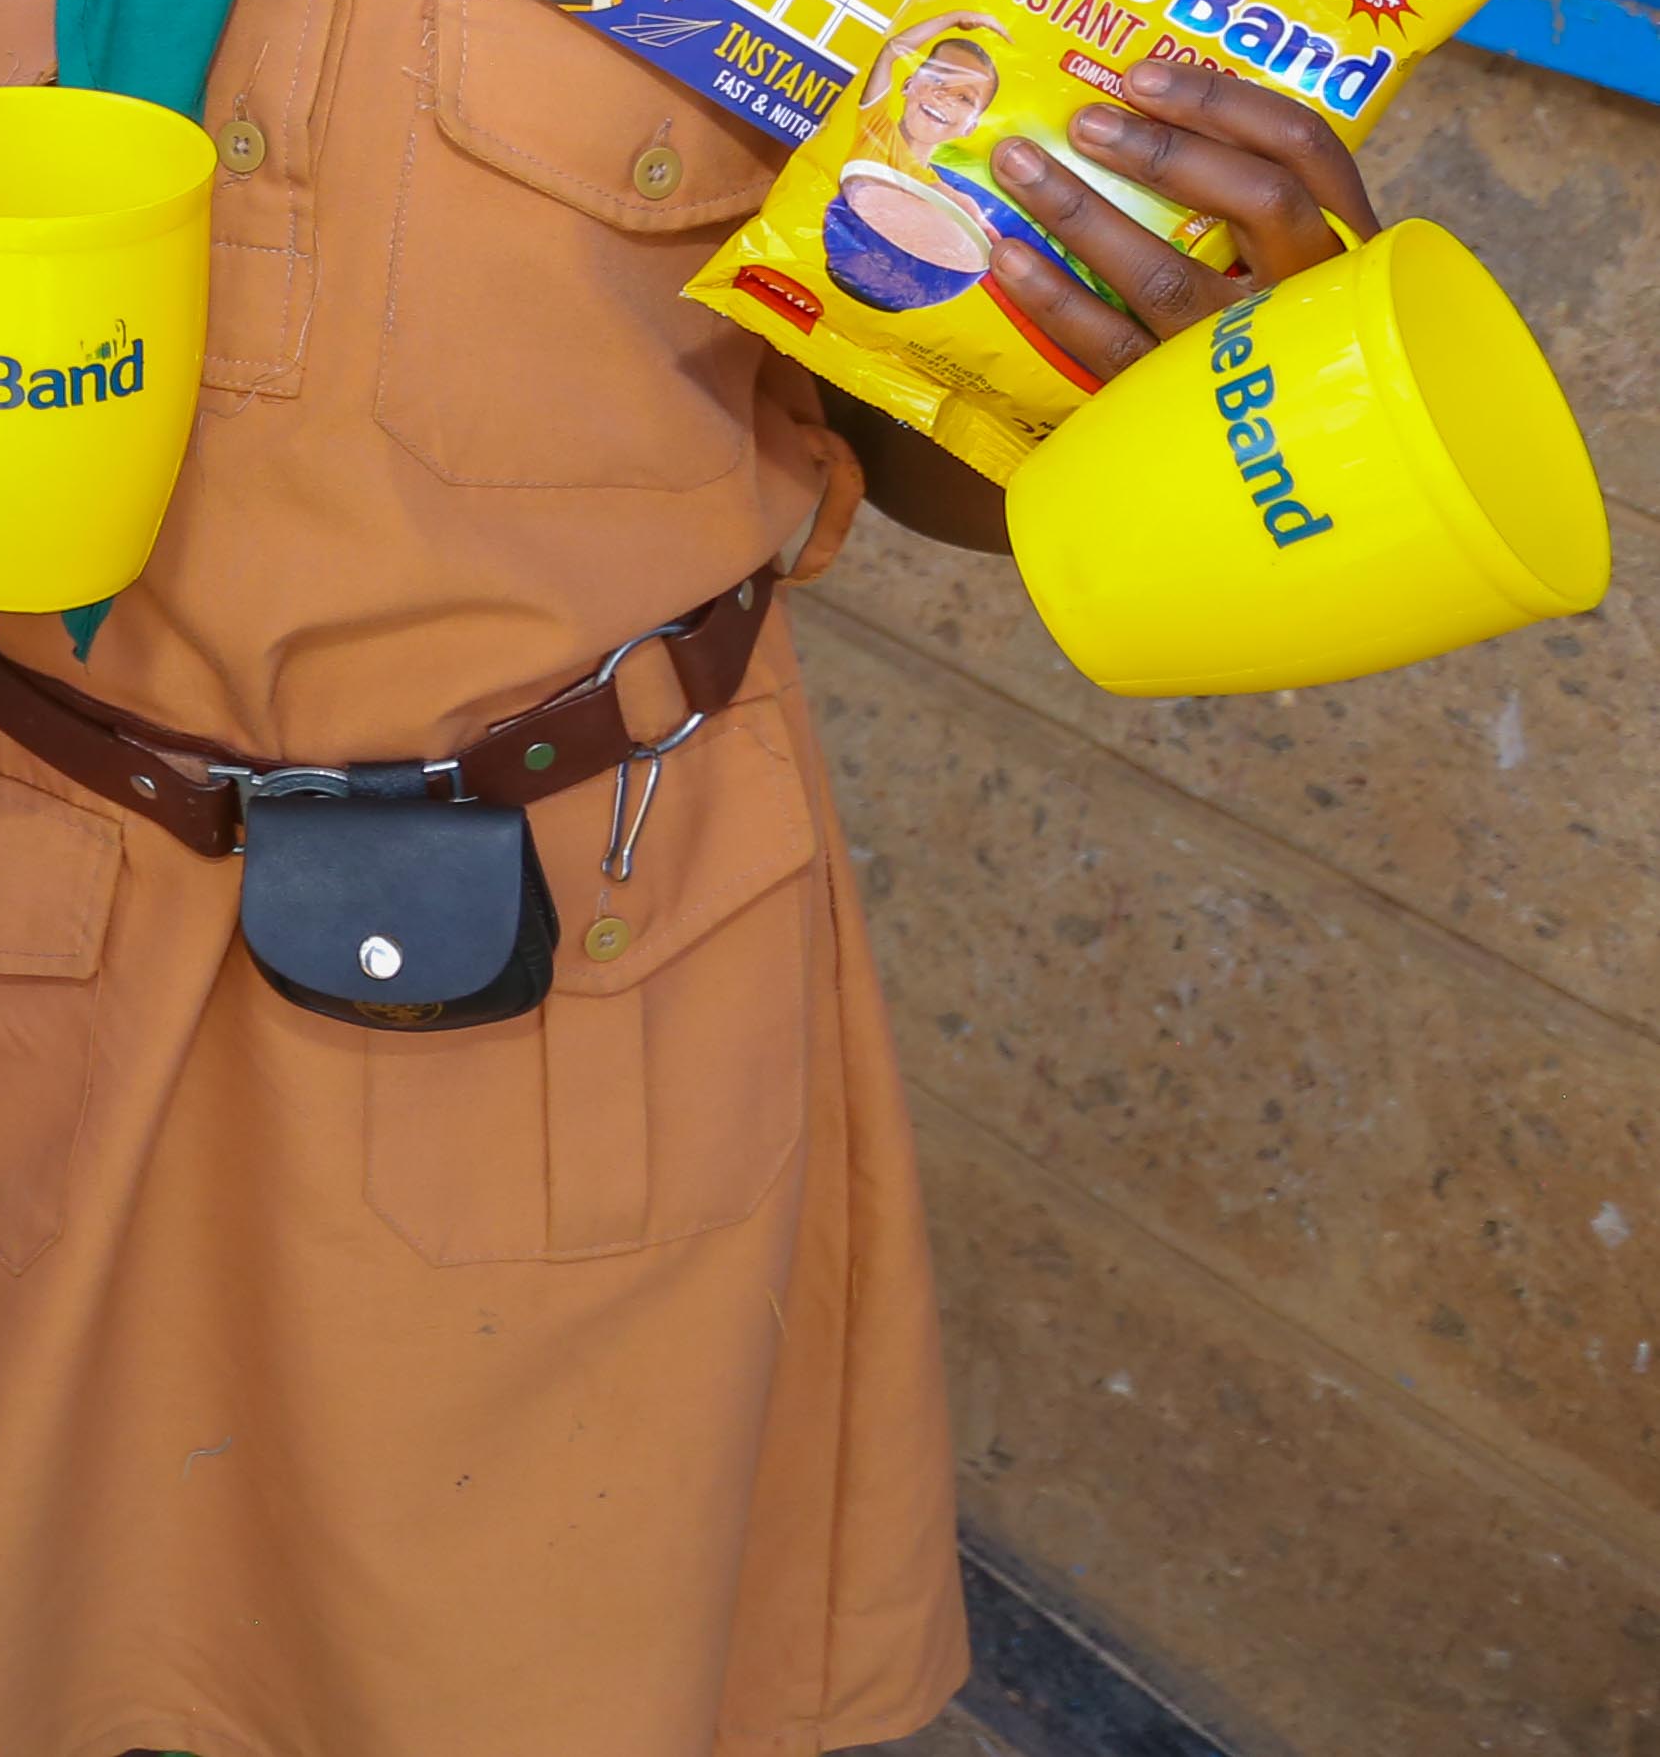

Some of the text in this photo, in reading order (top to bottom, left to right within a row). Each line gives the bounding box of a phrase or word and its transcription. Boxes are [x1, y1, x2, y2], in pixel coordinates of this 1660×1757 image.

[712, 69, 756, 104] FAST
[751, 93, 769, 116] &
[713, 22, 843, 116] INSTANT
[1215, 364, 1335, 549] Band
